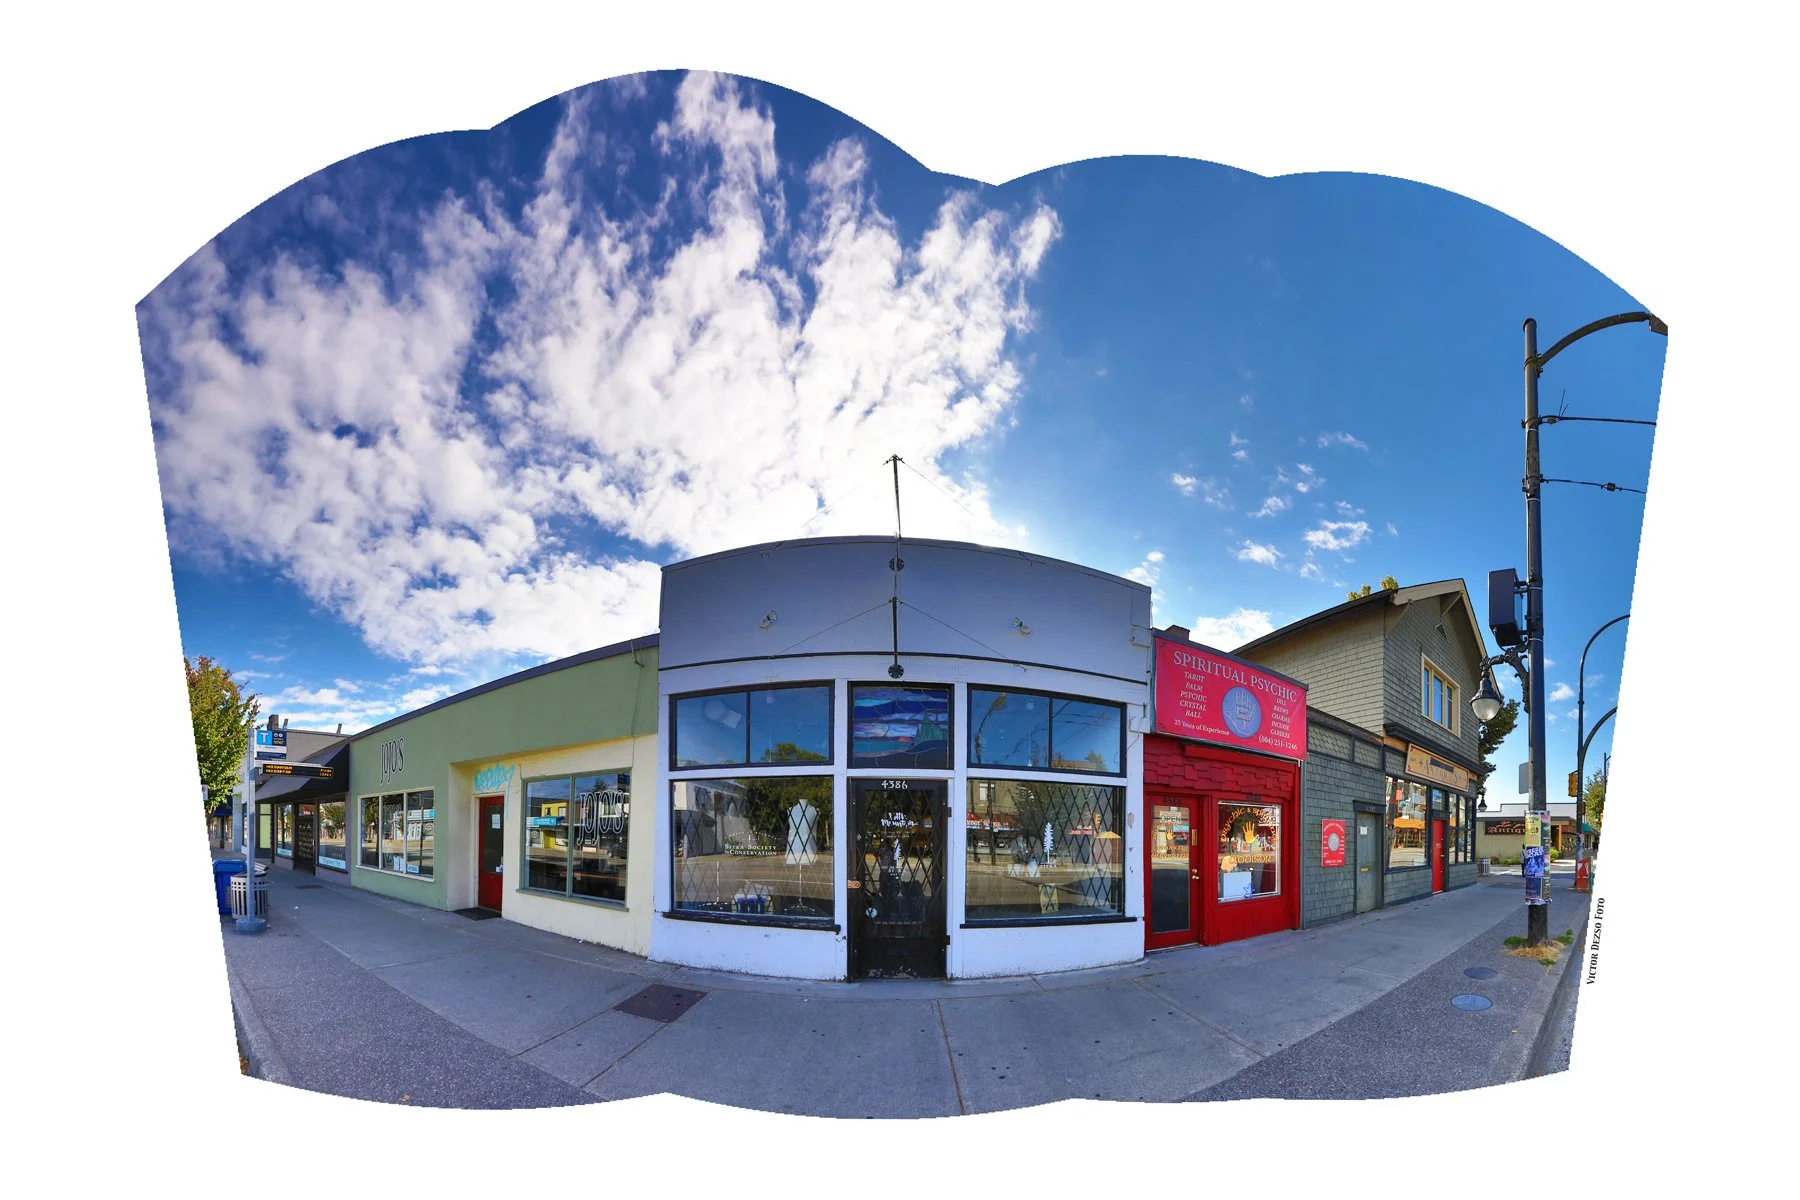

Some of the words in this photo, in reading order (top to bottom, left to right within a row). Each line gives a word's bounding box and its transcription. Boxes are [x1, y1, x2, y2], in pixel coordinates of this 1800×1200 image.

[1173, 651, 1247, 685] SPIRITUAL
[1251, 675, 1297, 703] PSYCHIC
[1184, 671, 1205, 682] TAROT
[1185, 682, 1203, 692] PALM
[1180, 691, 1207, 702] PSYCHIC
[1180, 700, 1207, 711] CRYSTAL
[1185, 710, 1202, 719] BALL
[1182, 720, 1195, 729] Years
[1202, 725, 1230, 736] Experience
[1271, 720, 1290, 731] INCENSE
[1270, 729, 1291, 739] CANDLES
[1258, 735, 1274, 746] (604)
[1274, 739, 1298, 751] 251-1246
[380, 736, 405, 785] JOJO'S
[881, 779, 909, 789] 4386
[576, 789, 624, 846] JOJO'S
[1160, 814, 1181, 822] OPEN
